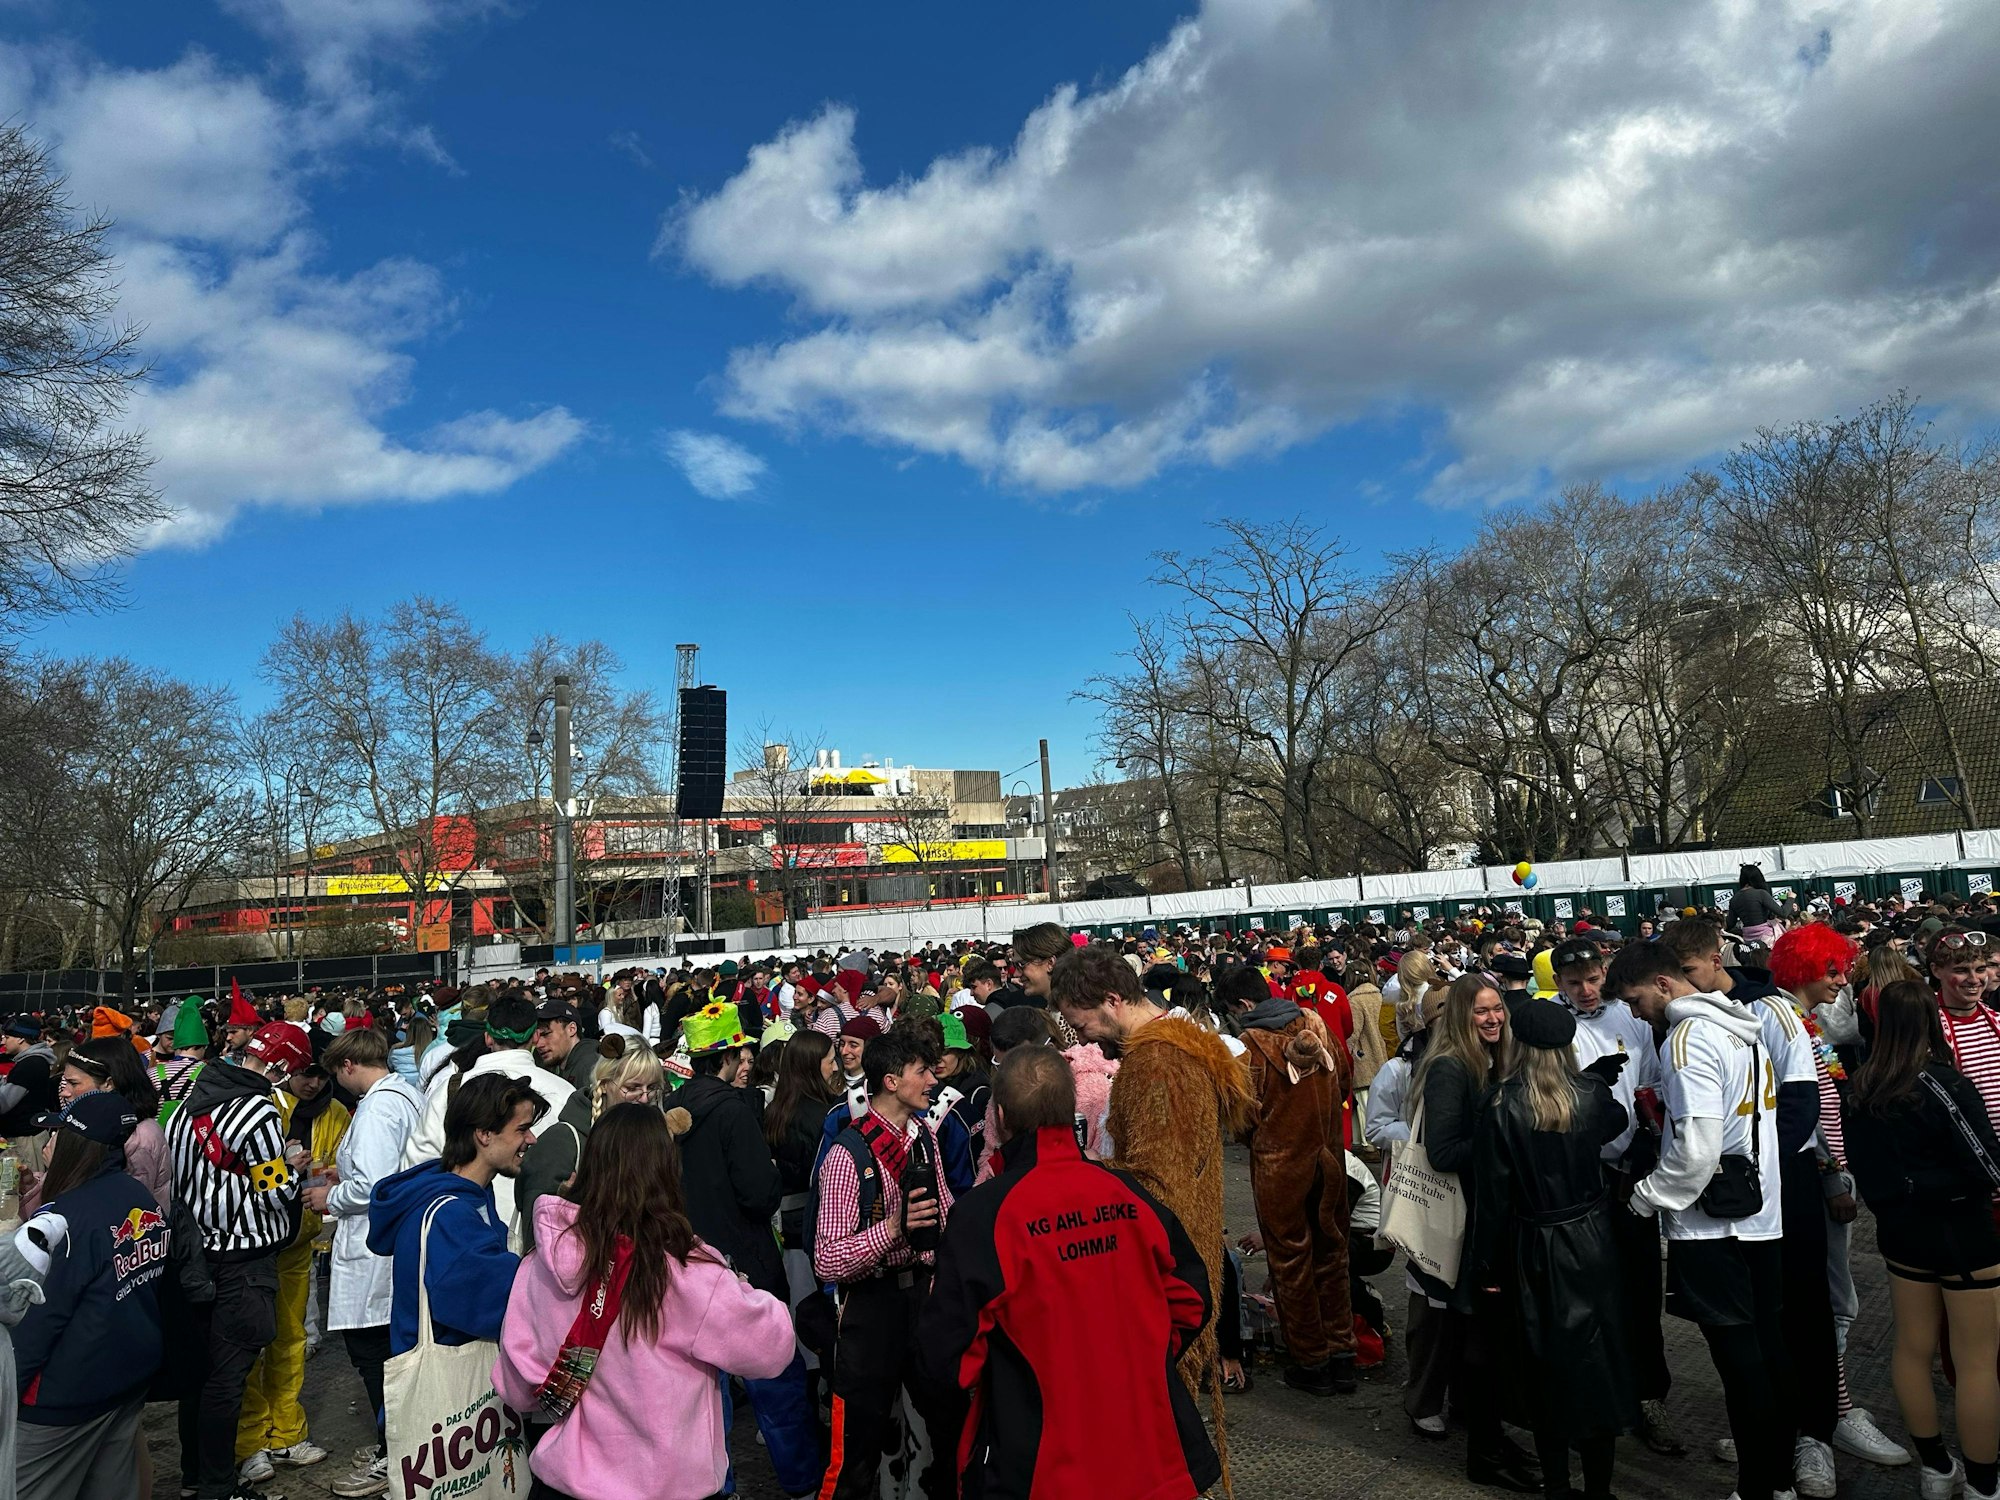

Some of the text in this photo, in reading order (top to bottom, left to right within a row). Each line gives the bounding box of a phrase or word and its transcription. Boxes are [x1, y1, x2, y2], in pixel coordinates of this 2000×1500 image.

[1901, 880, 1922, 893] DIXI
[1968, 876, 1991, 889] DIXI
[1715, 890, 1734, 903] DIXI
[1835, 884, 1855, 897] DIXI
[1555, 900, 1571, 911] DIXI
[1607, 897, 1624, 909] DIXI
[1414, 908, 1428, 919] DIXI
[1421, 1183, 1446, 1202] Ruhe
[1026, 1203, 1138, 1237] KG AHL JECKE
[1058, 1235, 1118, 1262] LOHMAR
[446, 1387, 499, 1427] DAS ORIGINA
